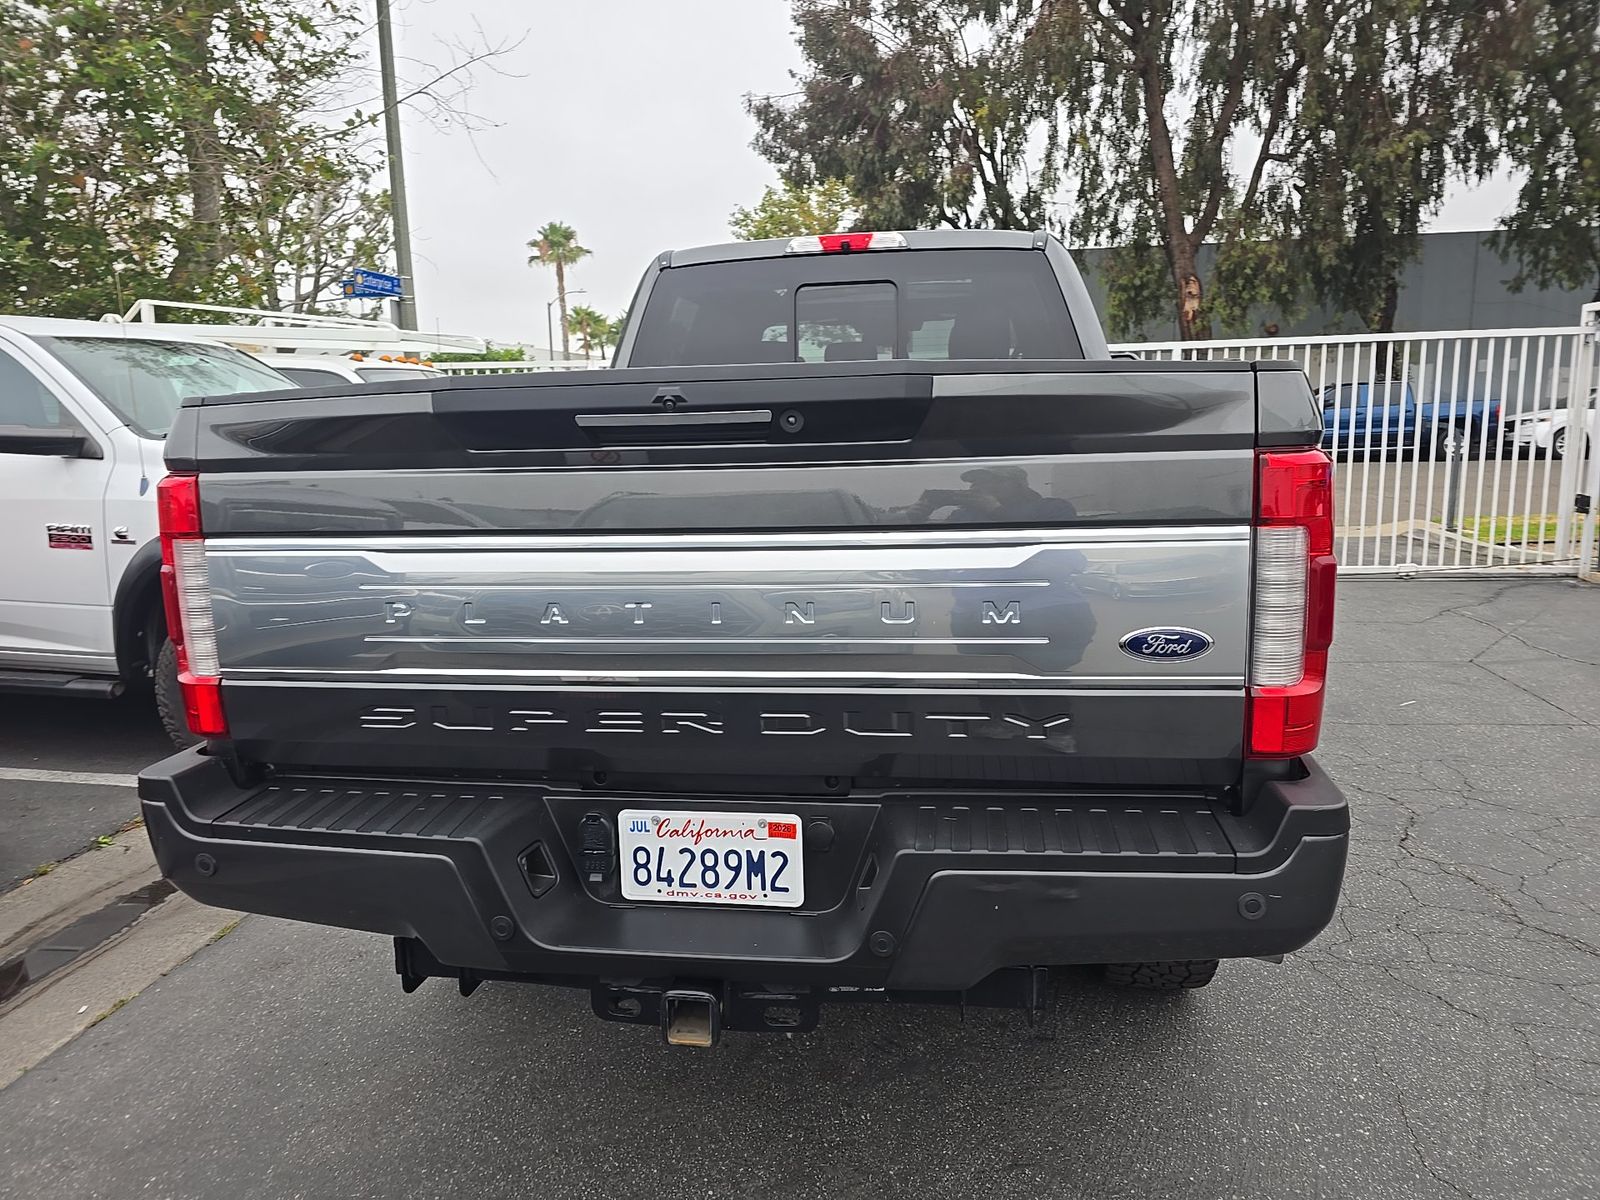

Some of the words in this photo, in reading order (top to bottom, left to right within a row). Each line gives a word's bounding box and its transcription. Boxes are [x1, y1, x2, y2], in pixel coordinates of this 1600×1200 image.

[49, 534, 92, 543] 2500
[384, 600, 1021, 625] PLATINUM
[1142, 633, 1193, 654] Ford
[360, 706, 724, 735] SUPER
[758, 711, 1071, 740] DUTY
[629, 820, 651, 833] JUL
[656, 817, 768, 845] California
[772, 823, 792, 833] 2026
[632, 846, 790, 893] 84289M2
[666, 889, 758, 900] dmv.ca.gov
